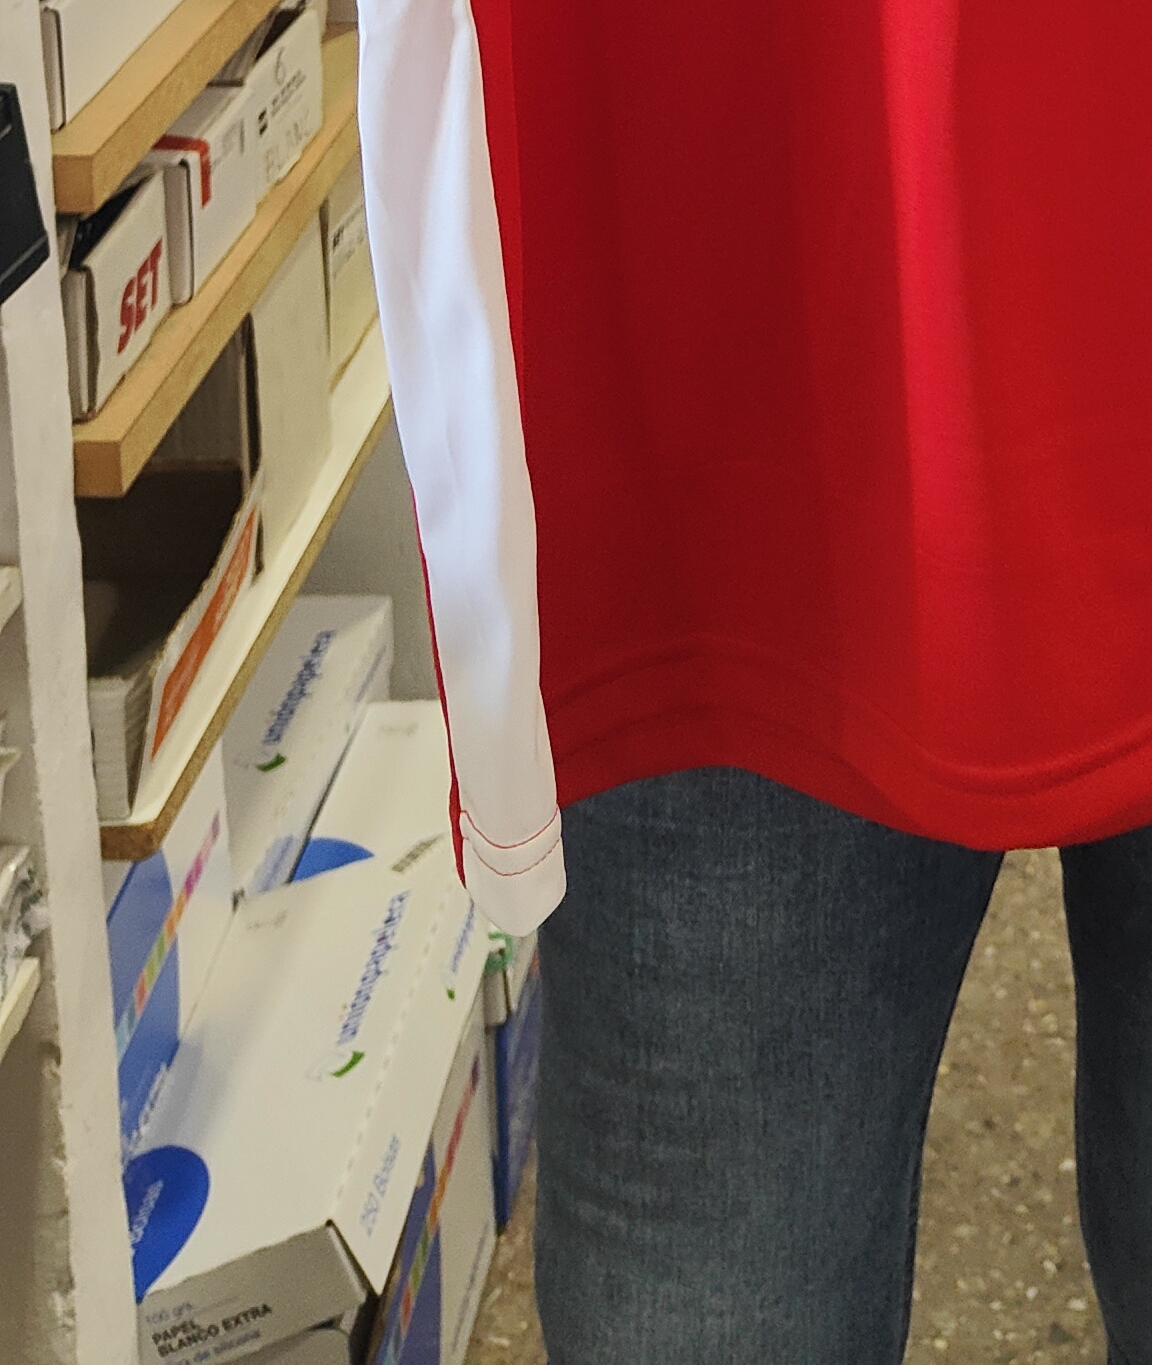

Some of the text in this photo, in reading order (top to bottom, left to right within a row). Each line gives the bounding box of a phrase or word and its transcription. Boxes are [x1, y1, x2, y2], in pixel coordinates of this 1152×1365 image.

[117, 236, 163, 355] SET
[151, 1319, 198, 1345] PAPEL
[157, 1303, 272, 1358] BLANCO EXTRA
